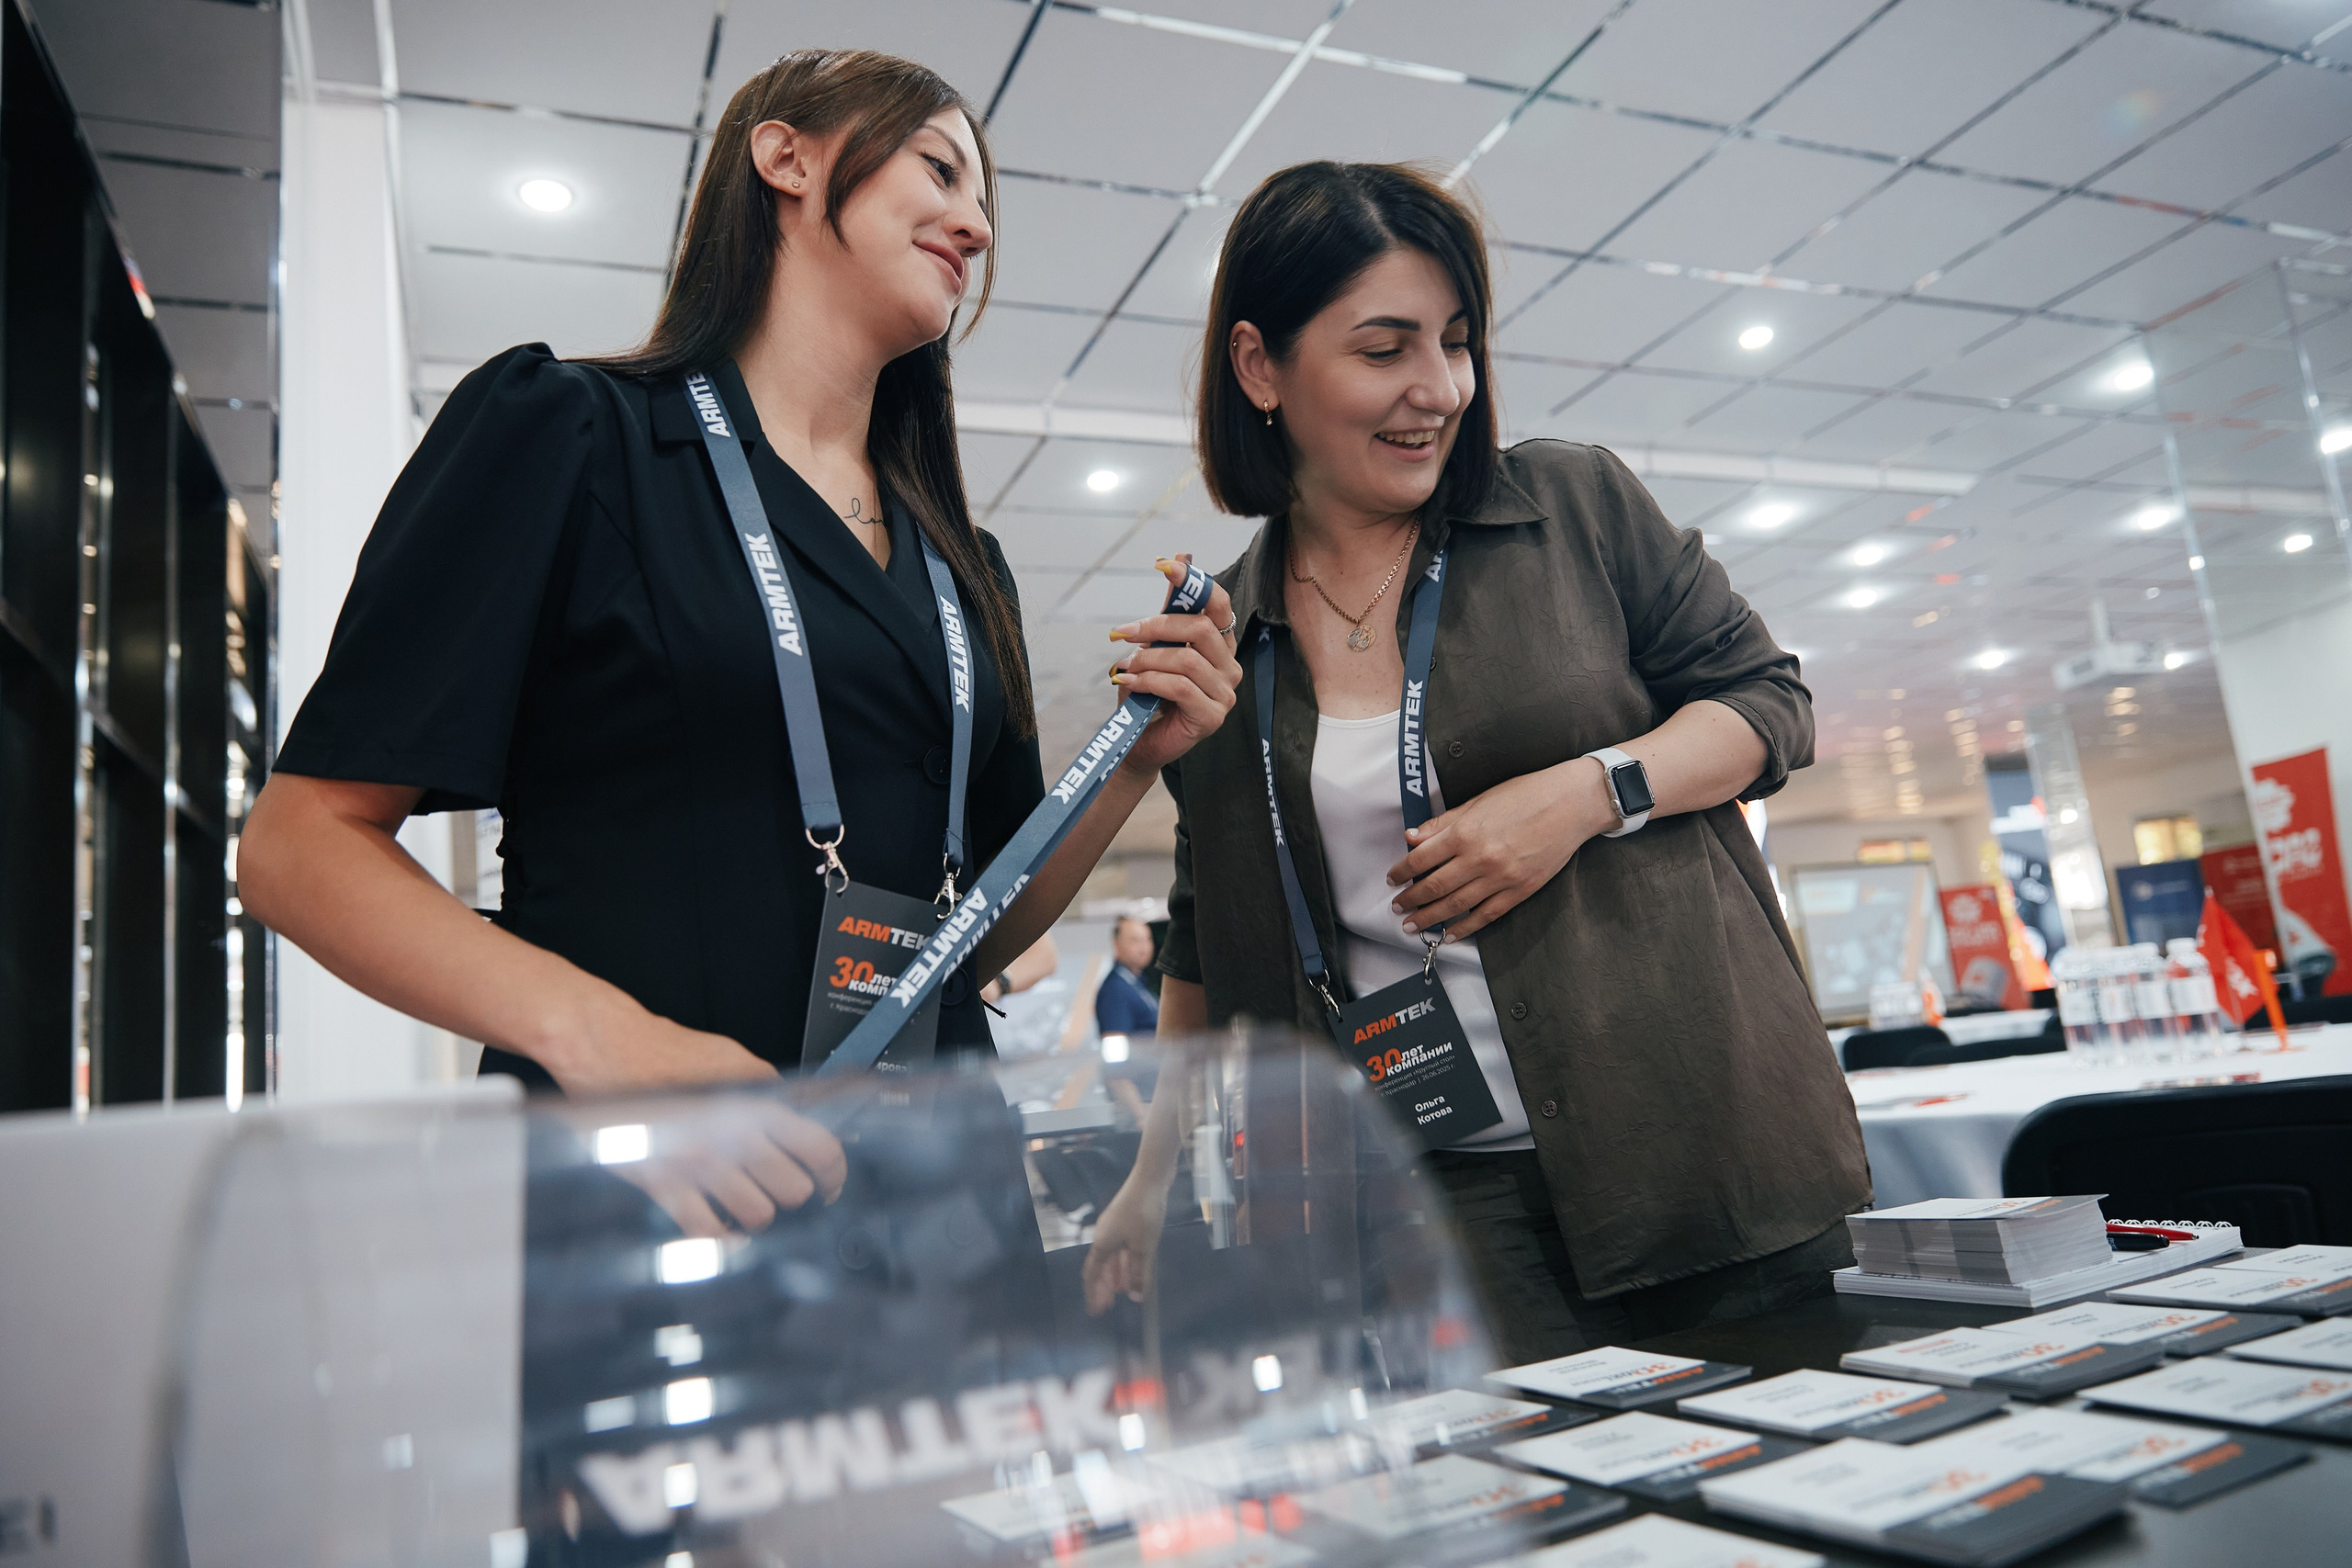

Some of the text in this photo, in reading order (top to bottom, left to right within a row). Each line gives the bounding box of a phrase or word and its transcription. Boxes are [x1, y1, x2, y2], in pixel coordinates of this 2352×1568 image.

[684, 371, 731, 438] ARMTE
[745, 533, 803, 657] ARMTEK
[940, 595, 970, 714] ARMTEK
[1051, 705, 1134, 805] ARMTEK
[1404, 679, 1423, 797] ARMTEK
[1261, 738, 1284, 847] ARMTEK
[830, 956, 875, 987] 30
[890, 886, 989, 1009] ARMTEK
[848, 979, 889, 997] комп
[1353, 997, 1436, 1045] ARMTEK
[1366, 1044, 1424, 1081] 30 лет
[1385, 1042, 1453, 1077] компании
[1415, 1096, 1445, 1112] Ольга
[1417, 1106, 1453, 1125] Котова
